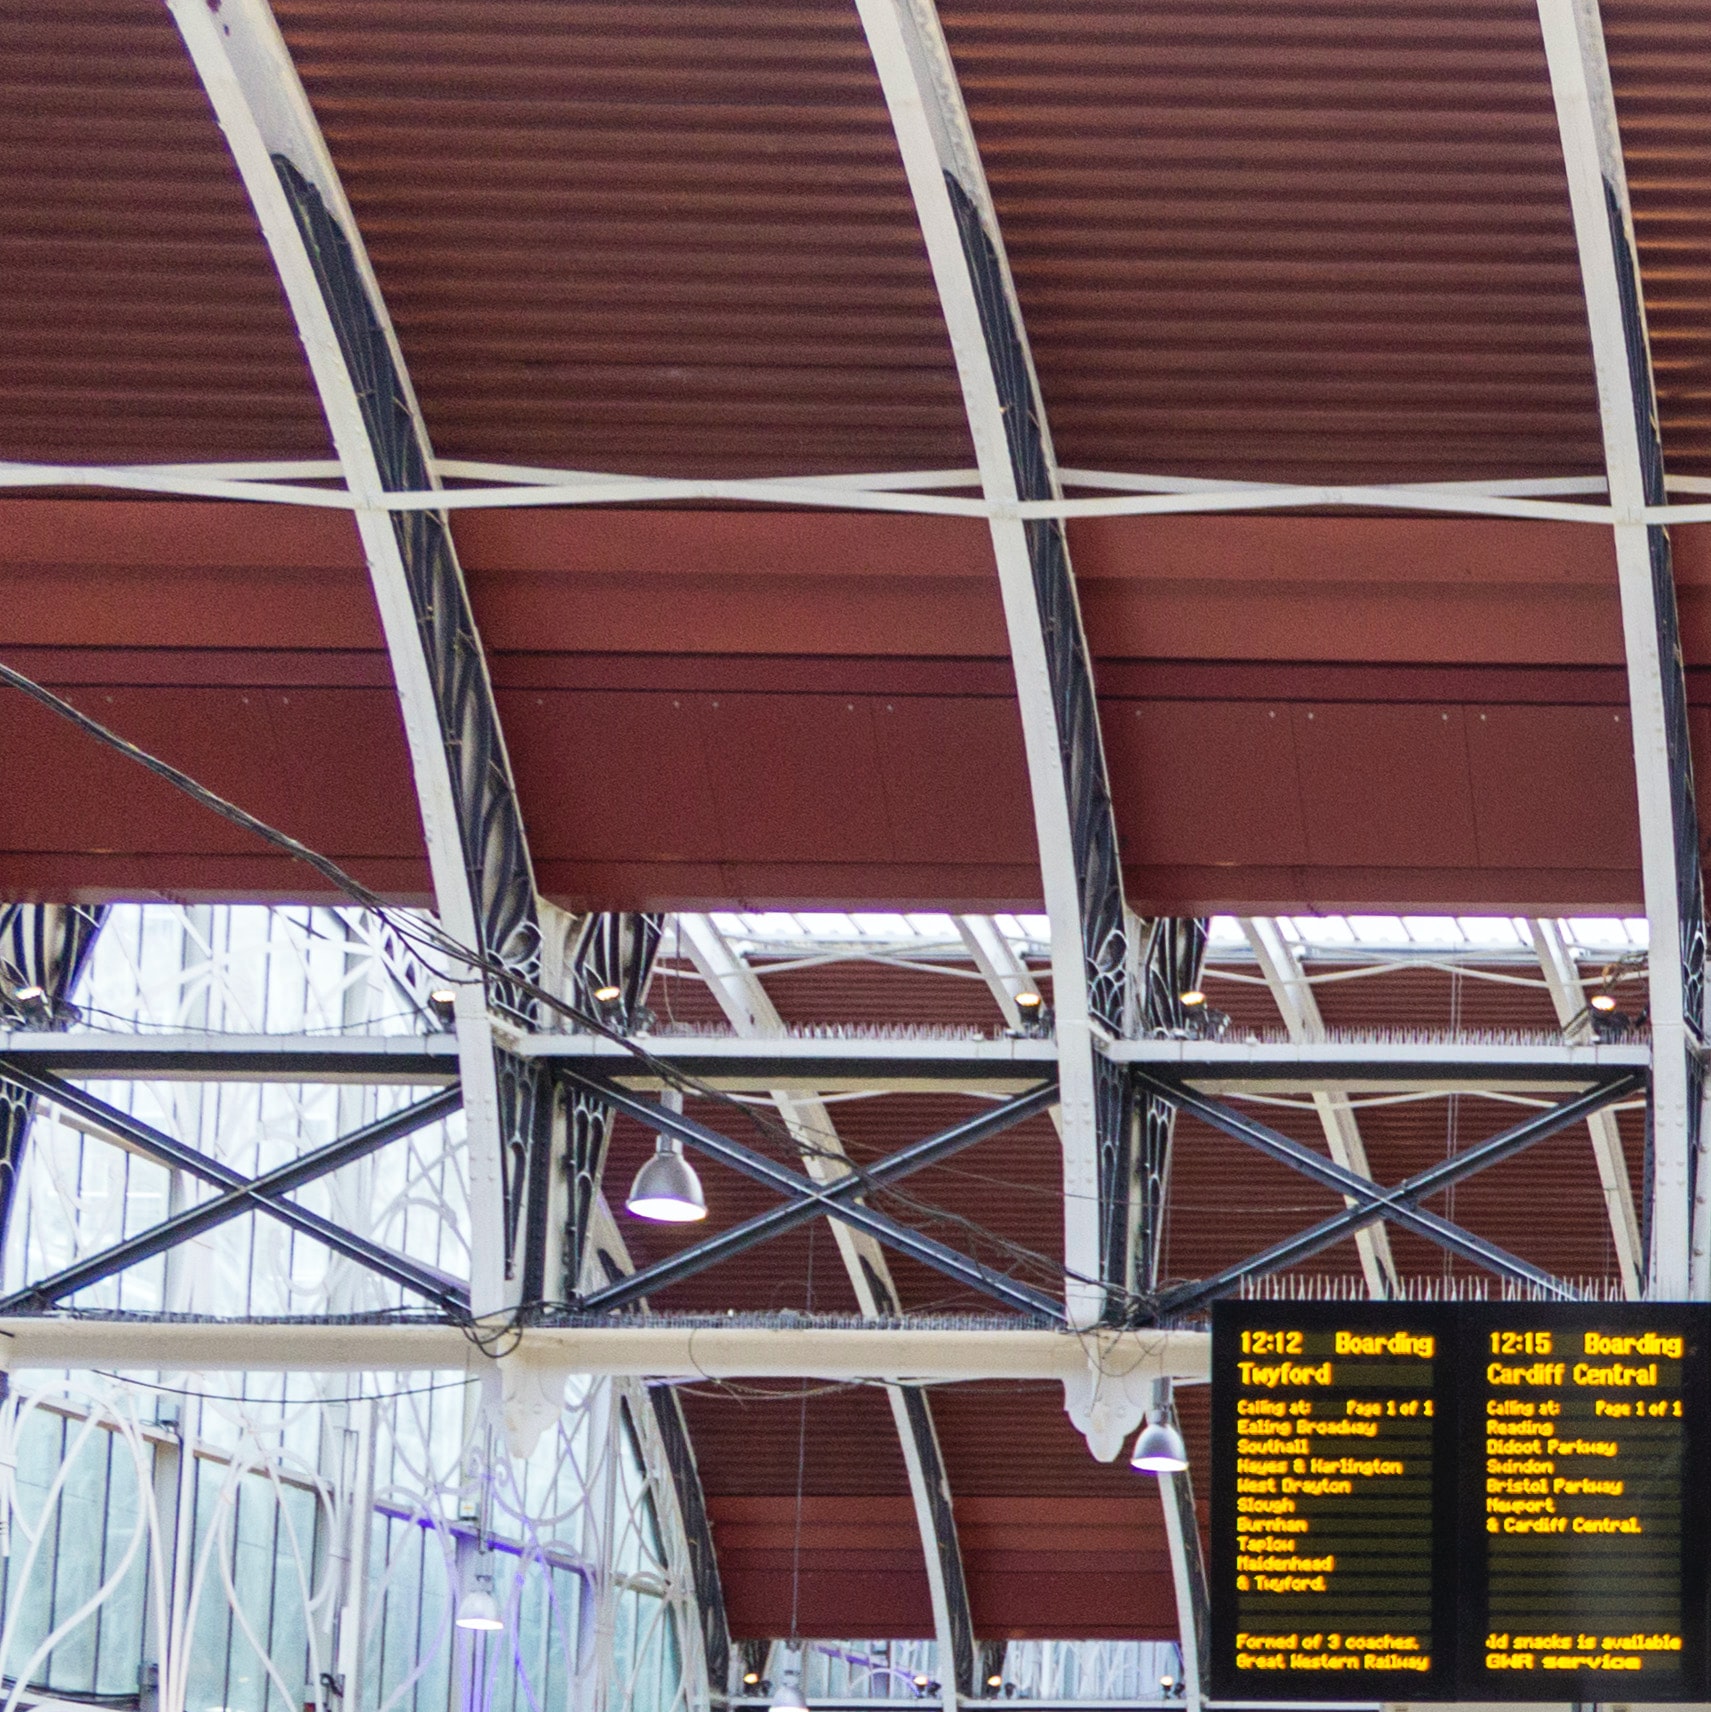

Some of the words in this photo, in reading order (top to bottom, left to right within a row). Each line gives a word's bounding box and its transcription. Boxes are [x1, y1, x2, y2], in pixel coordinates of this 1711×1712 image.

[1241, 1331, 1303, 1354] 12:12
[1336, 1332, 1434, 1358] Boarding
[1491, 1332, 1552, 1354] 12:15
[1584, 1332, 1683, 1358] Boarding
[1238, 1362, 1332, 1388] Twyford
[1487, 1363, 1565, 1385] Cardiff
[1573, 1363, 1657, 1386] Central
[1487, 1419, 1554, 1436] Reading
[1238, 1439, 1310, 1454] Southall
[1237, 1497, 1295, 1514] Slough
[1237, 1555, 1334, 1571] Maidenhead
